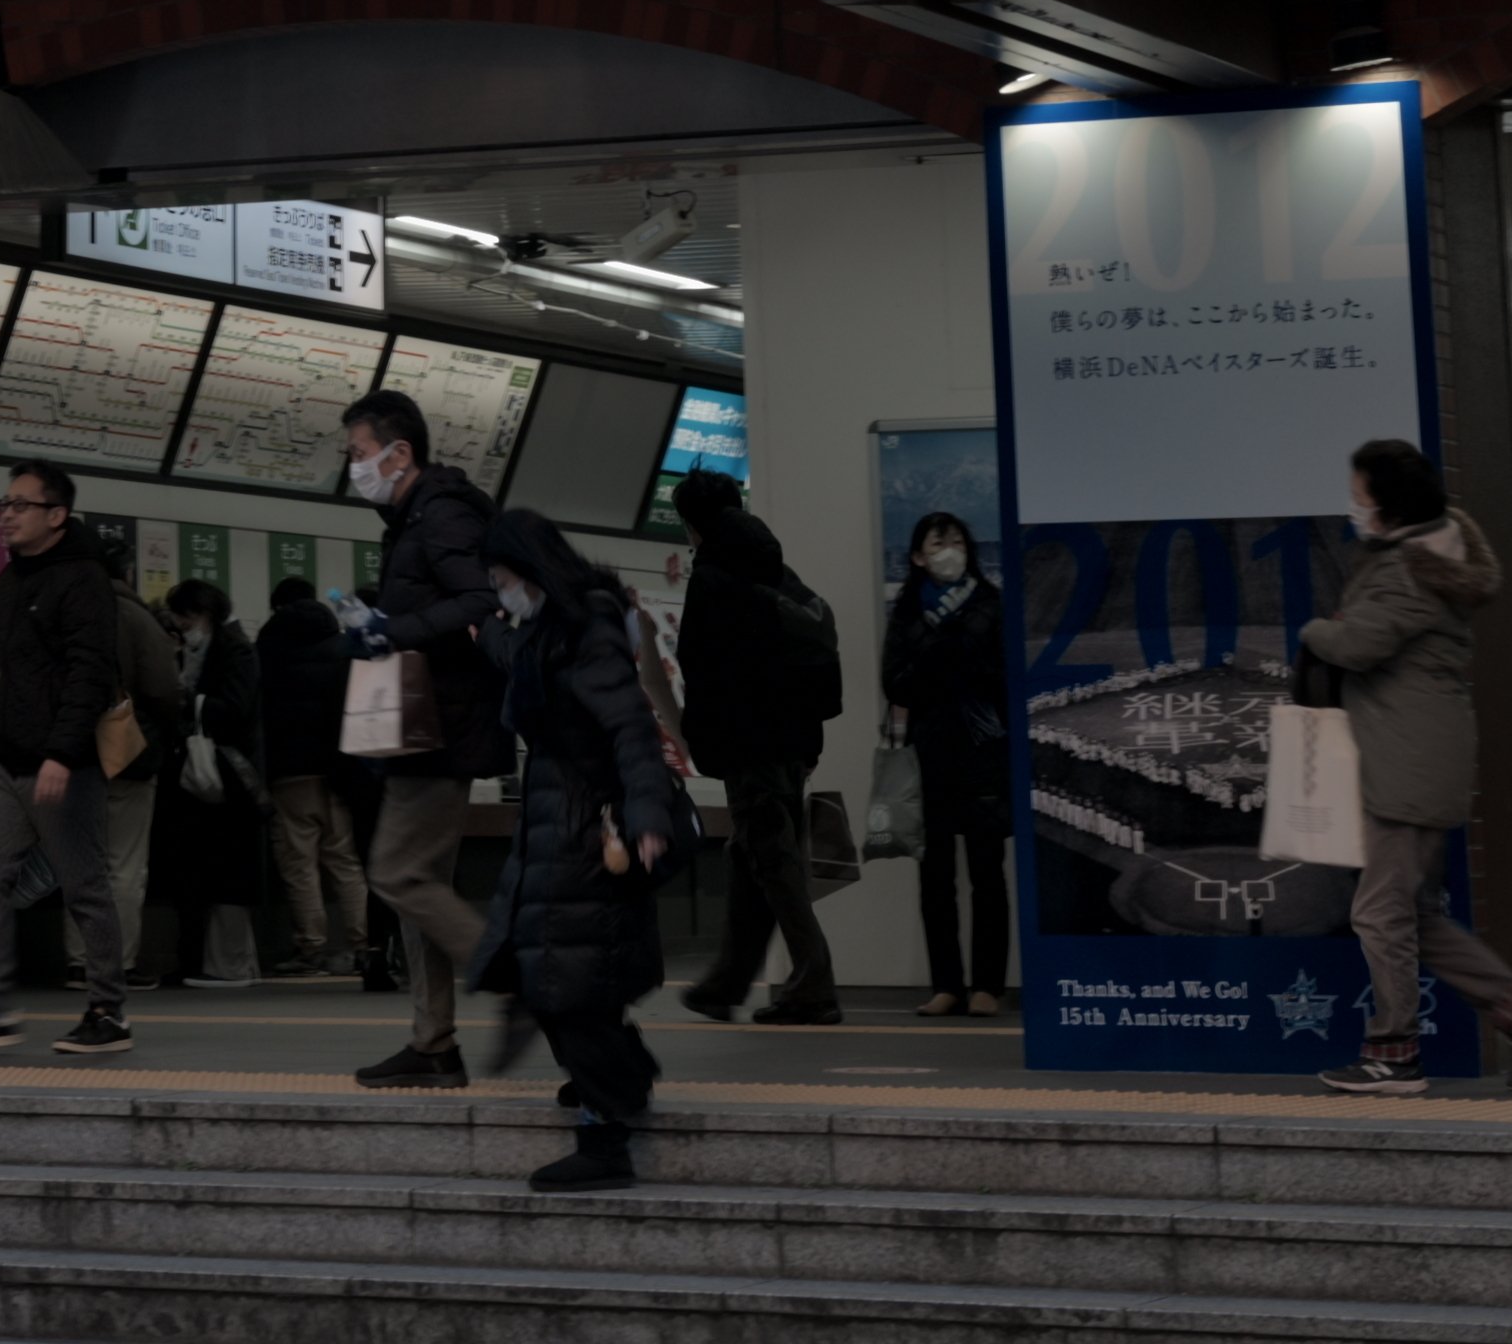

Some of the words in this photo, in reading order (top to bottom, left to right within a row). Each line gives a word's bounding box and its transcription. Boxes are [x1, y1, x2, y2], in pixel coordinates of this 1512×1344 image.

[1050, 297, 1376, 334] 僕らの夢は、ここから始まった。
[1053, 344, 1379, 381] 横浜DeNAベイスターズ誕生。
[1057, 978, 1136, 1000] Thanks,
[1140, 980, 1177, 998] and
[1180, 980, 1212, 999] We
[1215, 979, 1249, 999] Go!
[1059, 1006, 1107, 1026] 15th
[1116, 1007, 1251, 1031] Anniversary
